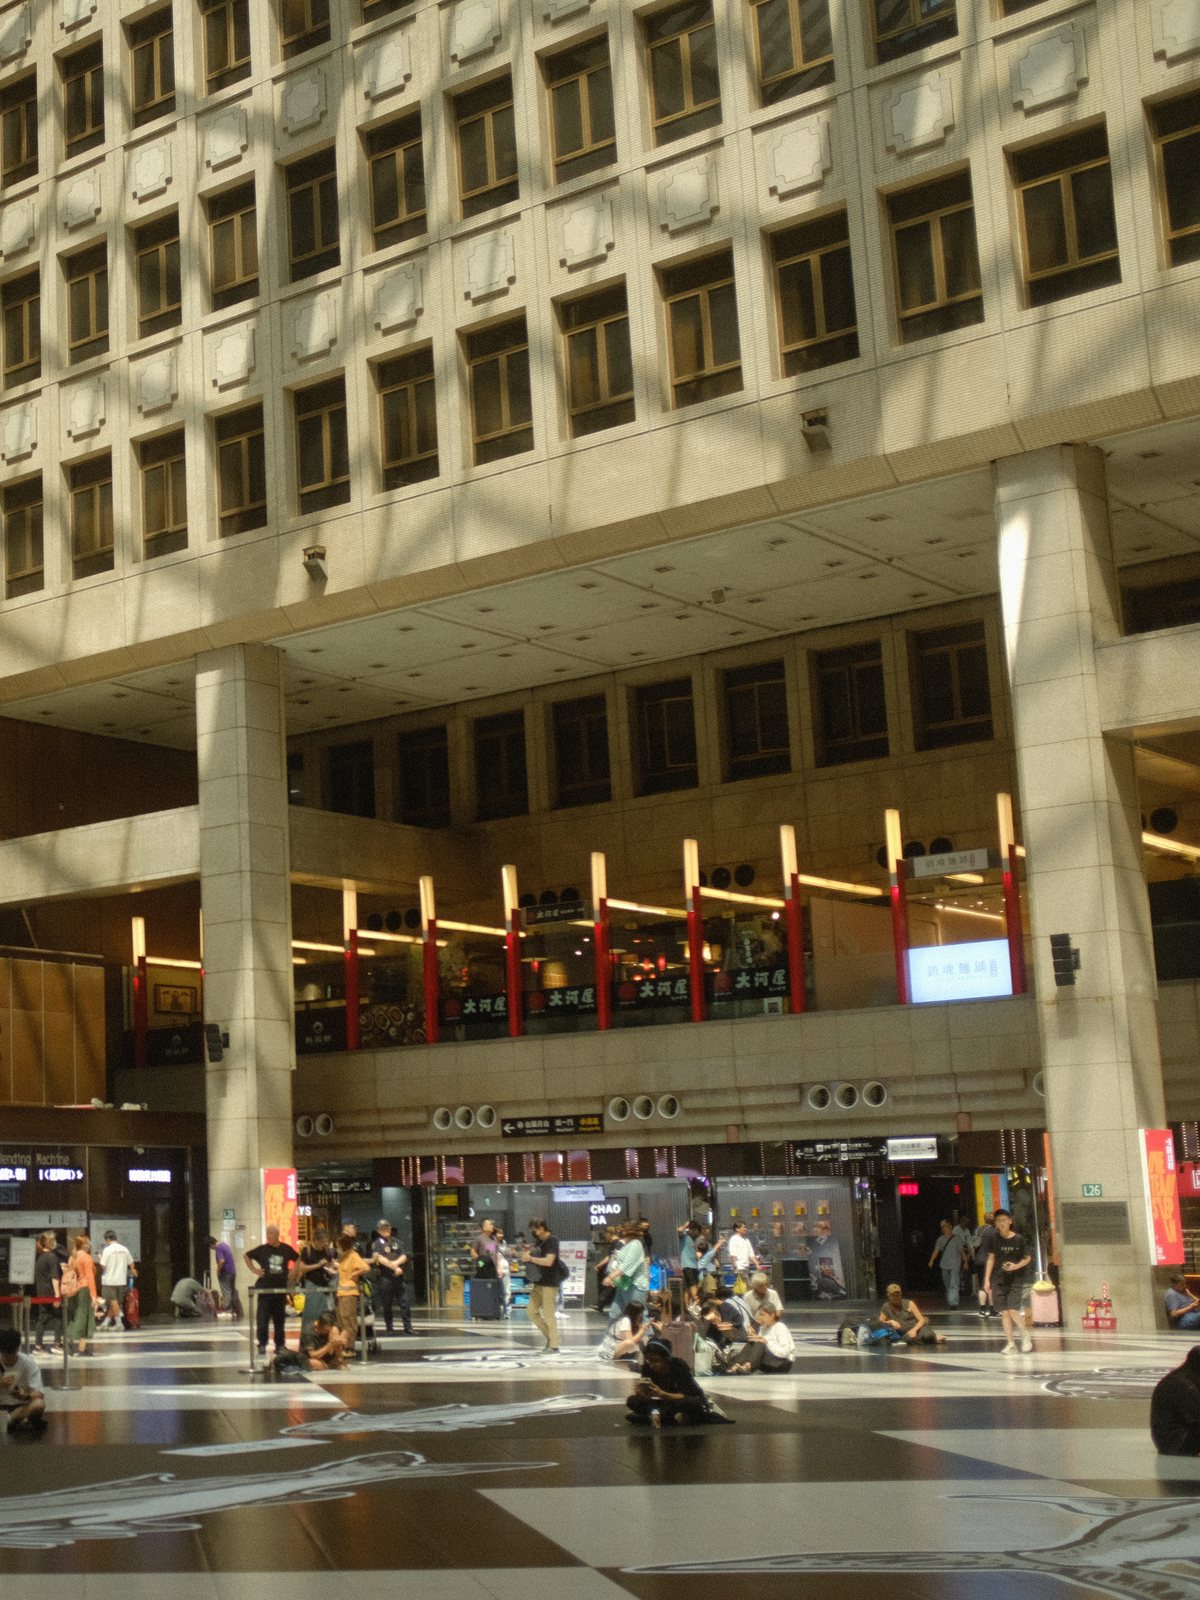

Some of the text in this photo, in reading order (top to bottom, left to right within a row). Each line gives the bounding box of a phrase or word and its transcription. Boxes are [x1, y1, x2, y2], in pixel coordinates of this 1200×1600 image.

[735, 969, 786, 988] 大河屋
[639, 978, 688, 998] 大河屋
[549, 988, 594, 1007] 大河屋
[463, 996, 506, 1014] 大河屋
[36, 1153, 70, 1165] Machine
[1084, 1185, 1100, 1196] L26
[296, 1206, 311, 1216] YS
[590, 1204, 621, 1214] CHAO
[590, 1215, 607, 1225] DA
